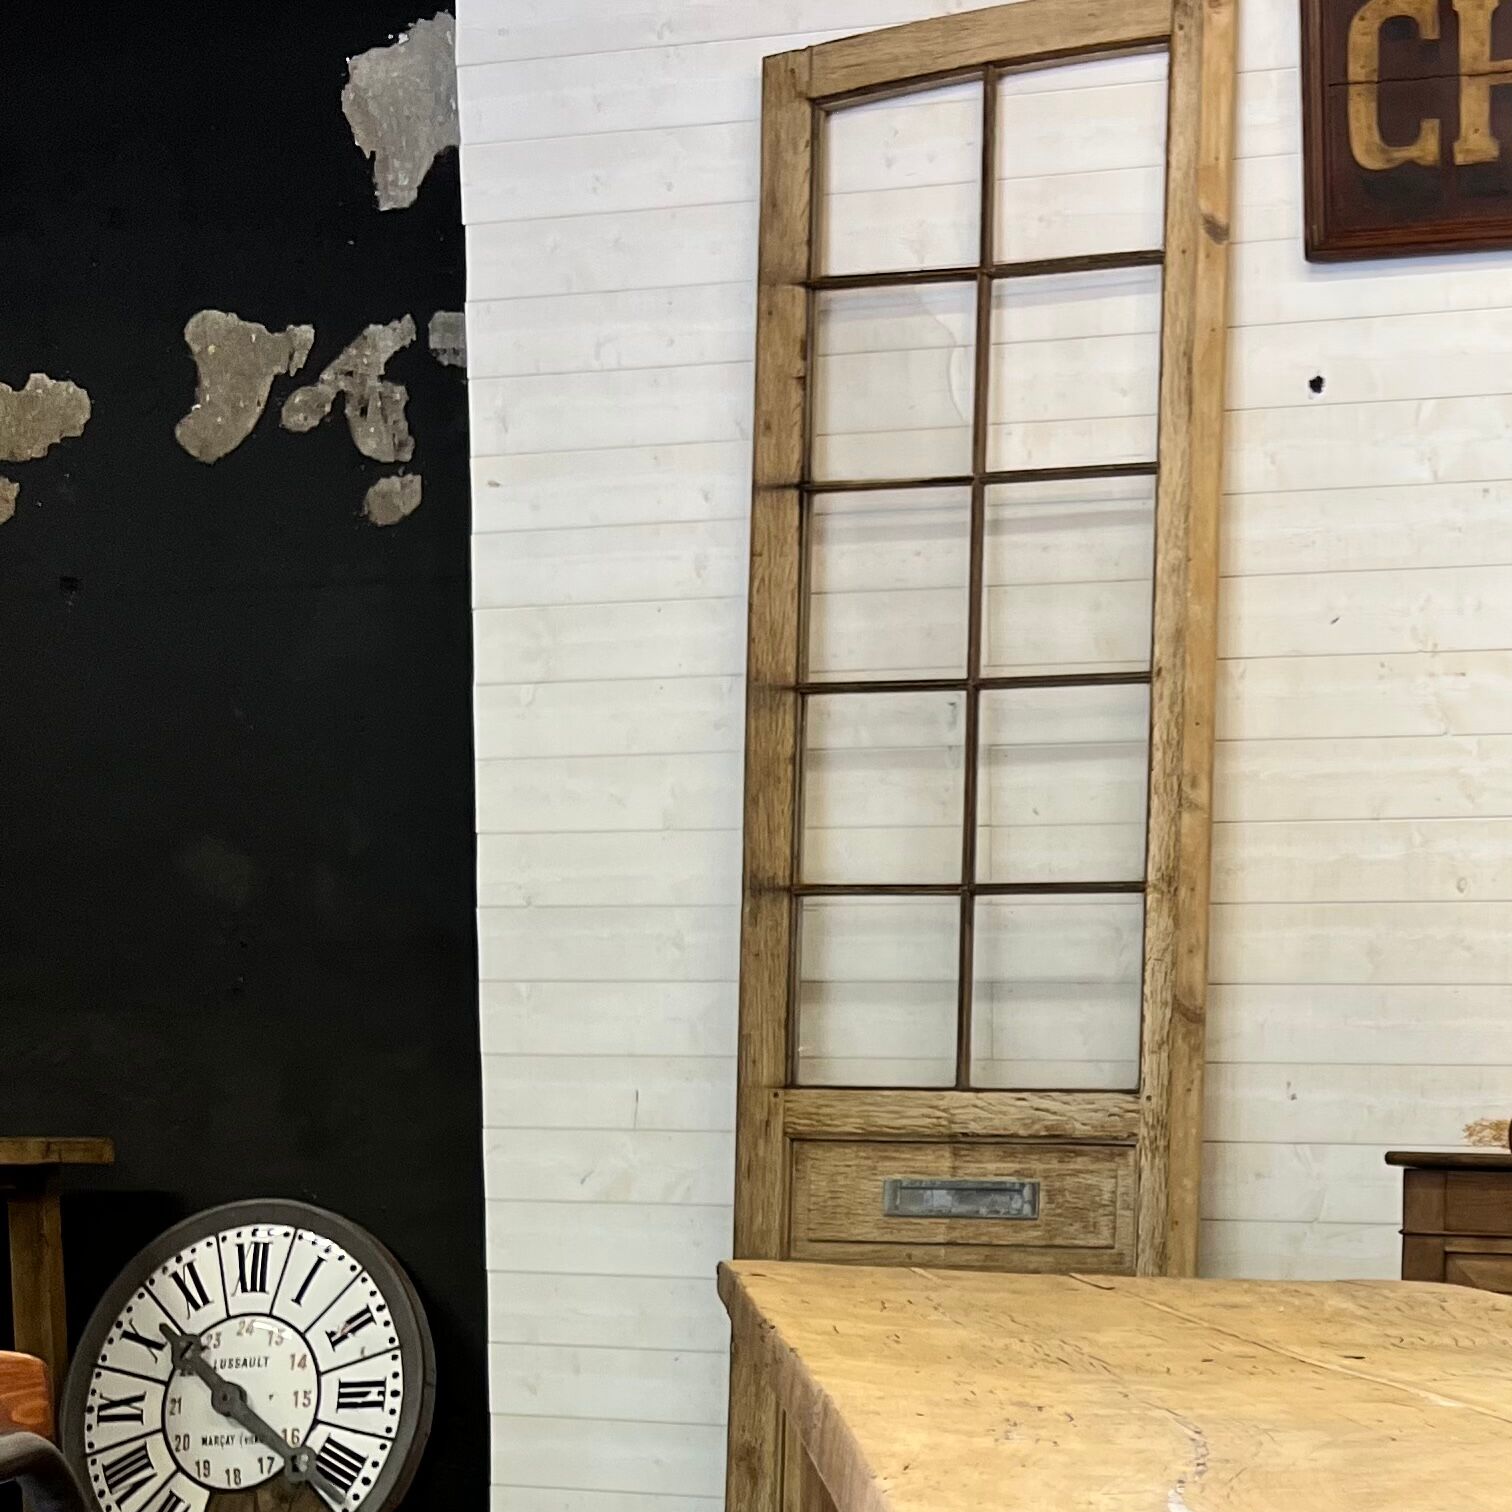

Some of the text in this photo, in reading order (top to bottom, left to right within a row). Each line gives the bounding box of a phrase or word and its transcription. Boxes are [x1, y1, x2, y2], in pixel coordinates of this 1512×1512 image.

[231, 1241, 273, 1298] XII
[291, 1256, 328, 1307] I
[168, 1258, 214, 1320] XI
[119, 1318, 168, 1365] X
[236, 1319, 256, 1336] 24
[325, 1303, 377, 1352] II
[290, 1353, 308, 1372] 14
[97, 1391, 147, 1428] IX
[169, 1397, 183, 1416] 21
[293, 1390, 312, 1409] 15
[336, 1376, 387, 1414] III
[174, 1433, 190, 1453] 20
[102, 1439, 158, 1512] VIII
[195, 1459, 211, 1479] 19
[225, 1468, 242, 1487] 18
[257, 1456, 276, 1476] 17
[315, 1433, 369, 1495] IIII
